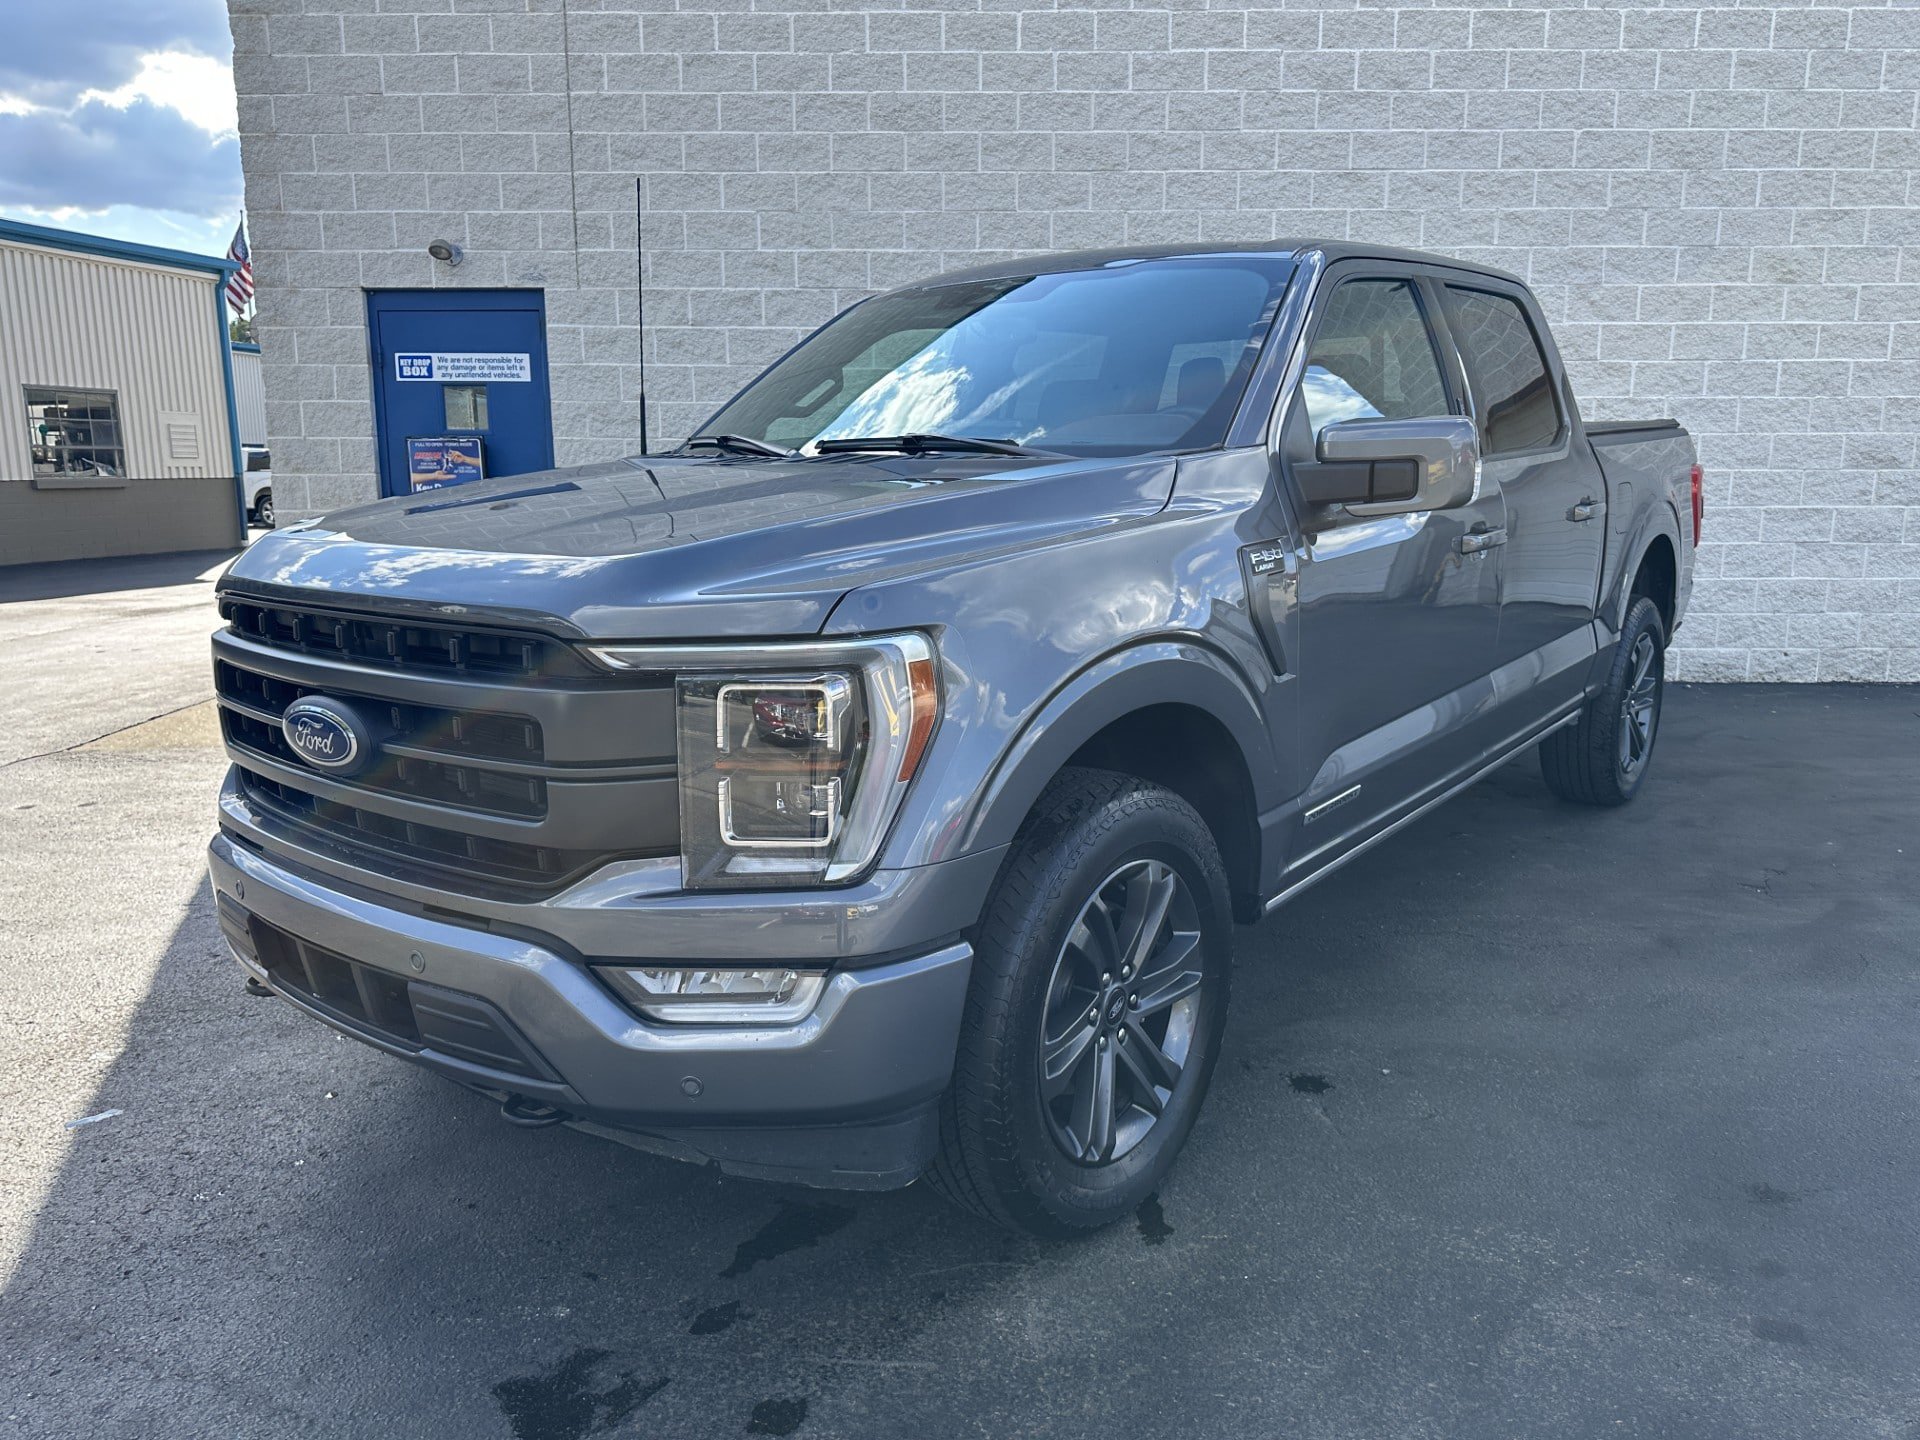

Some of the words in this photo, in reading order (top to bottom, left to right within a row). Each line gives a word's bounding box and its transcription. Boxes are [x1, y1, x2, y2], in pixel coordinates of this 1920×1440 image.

[474, 356, 512, 364] responsible
[403, 367, 429, 377] BOX
[1250, 548, 1283, 564] F-150
[295, 717, 334, 754] Ford
